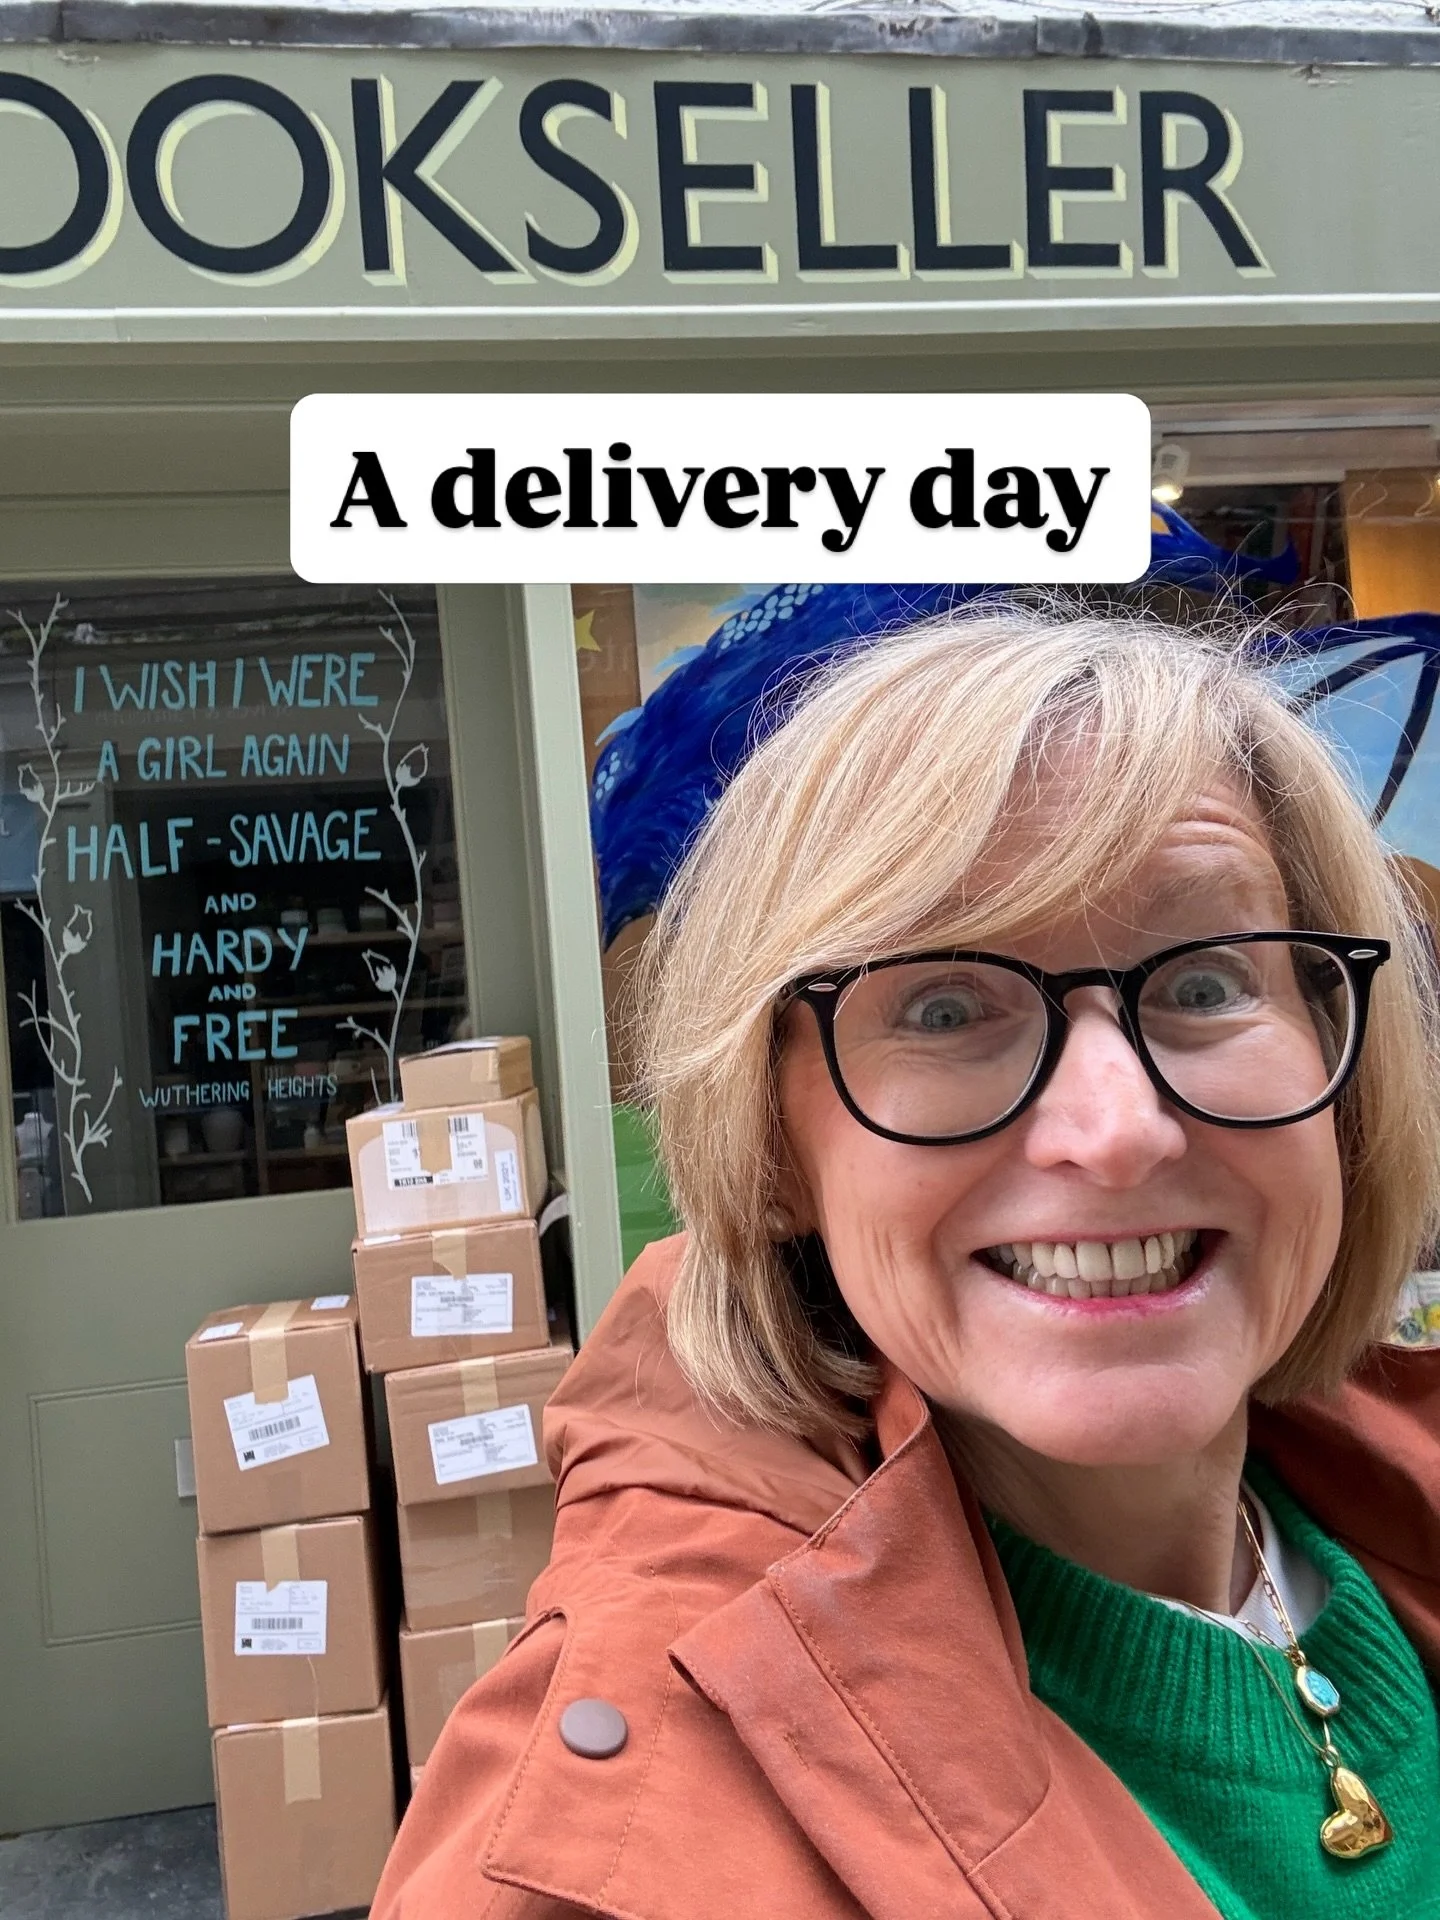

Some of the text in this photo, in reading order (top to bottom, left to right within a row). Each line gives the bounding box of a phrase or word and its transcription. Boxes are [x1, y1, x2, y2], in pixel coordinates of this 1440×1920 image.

[74, 652, 379, 713] I WISH I WERE
[97, 734, 350, 782] A GIRL AGAIN
[204, 893, 257, 914] AND
[151, 928, 309, 977] HARDY
[208, 983, 257, 1002] AND
[173, 1009, 299, 1064] FREE
[138, 1074, 338, 1109] WUTHERING HEIGHTS
